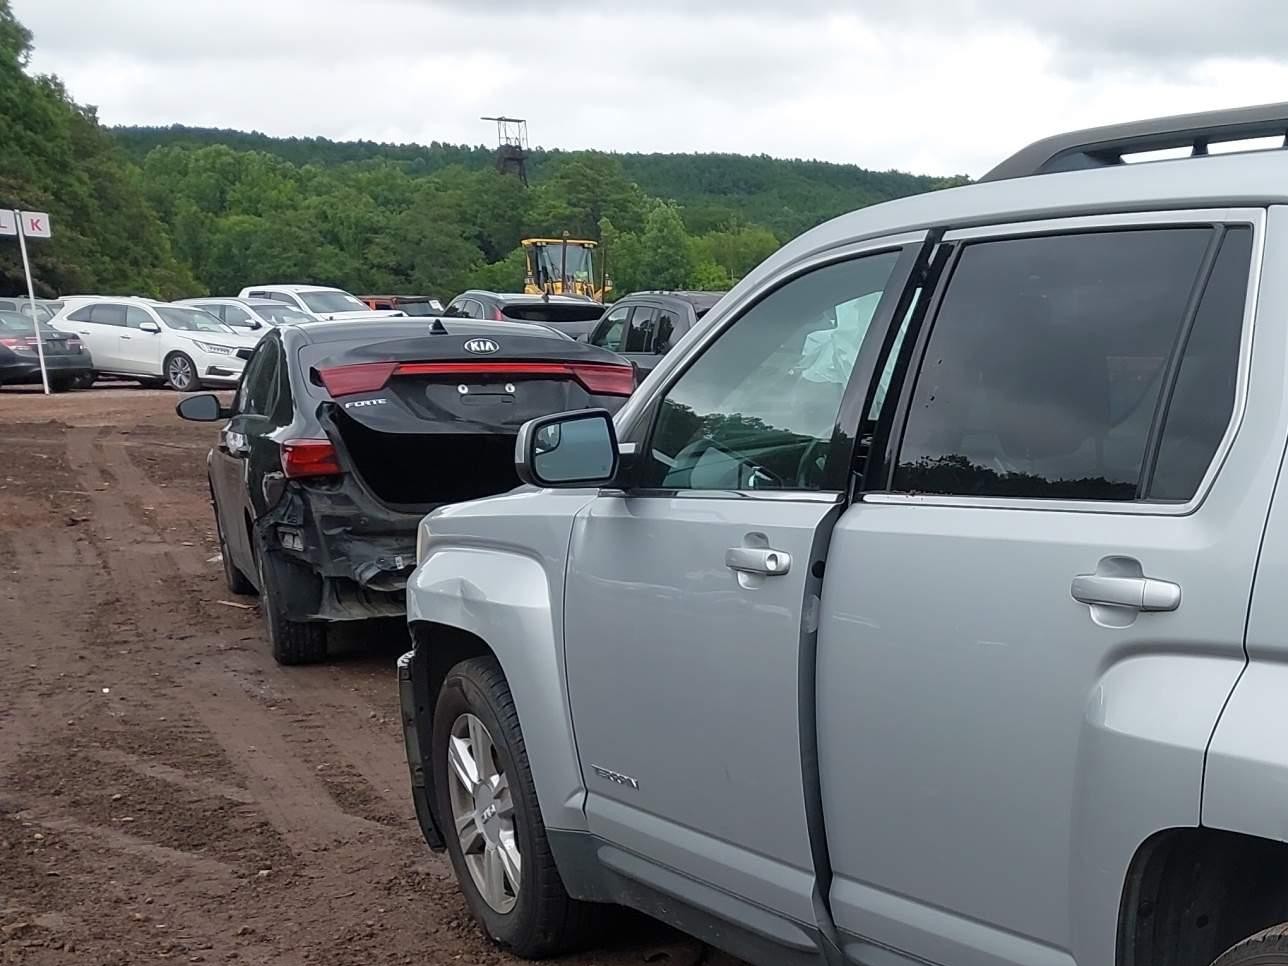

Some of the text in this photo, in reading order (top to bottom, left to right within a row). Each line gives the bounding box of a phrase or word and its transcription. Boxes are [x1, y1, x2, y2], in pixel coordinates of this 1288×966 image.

[30, 218, 42, 231] K
[470, 341, 495, 351] KIA
[344, 398, 387, 409] FORTE
